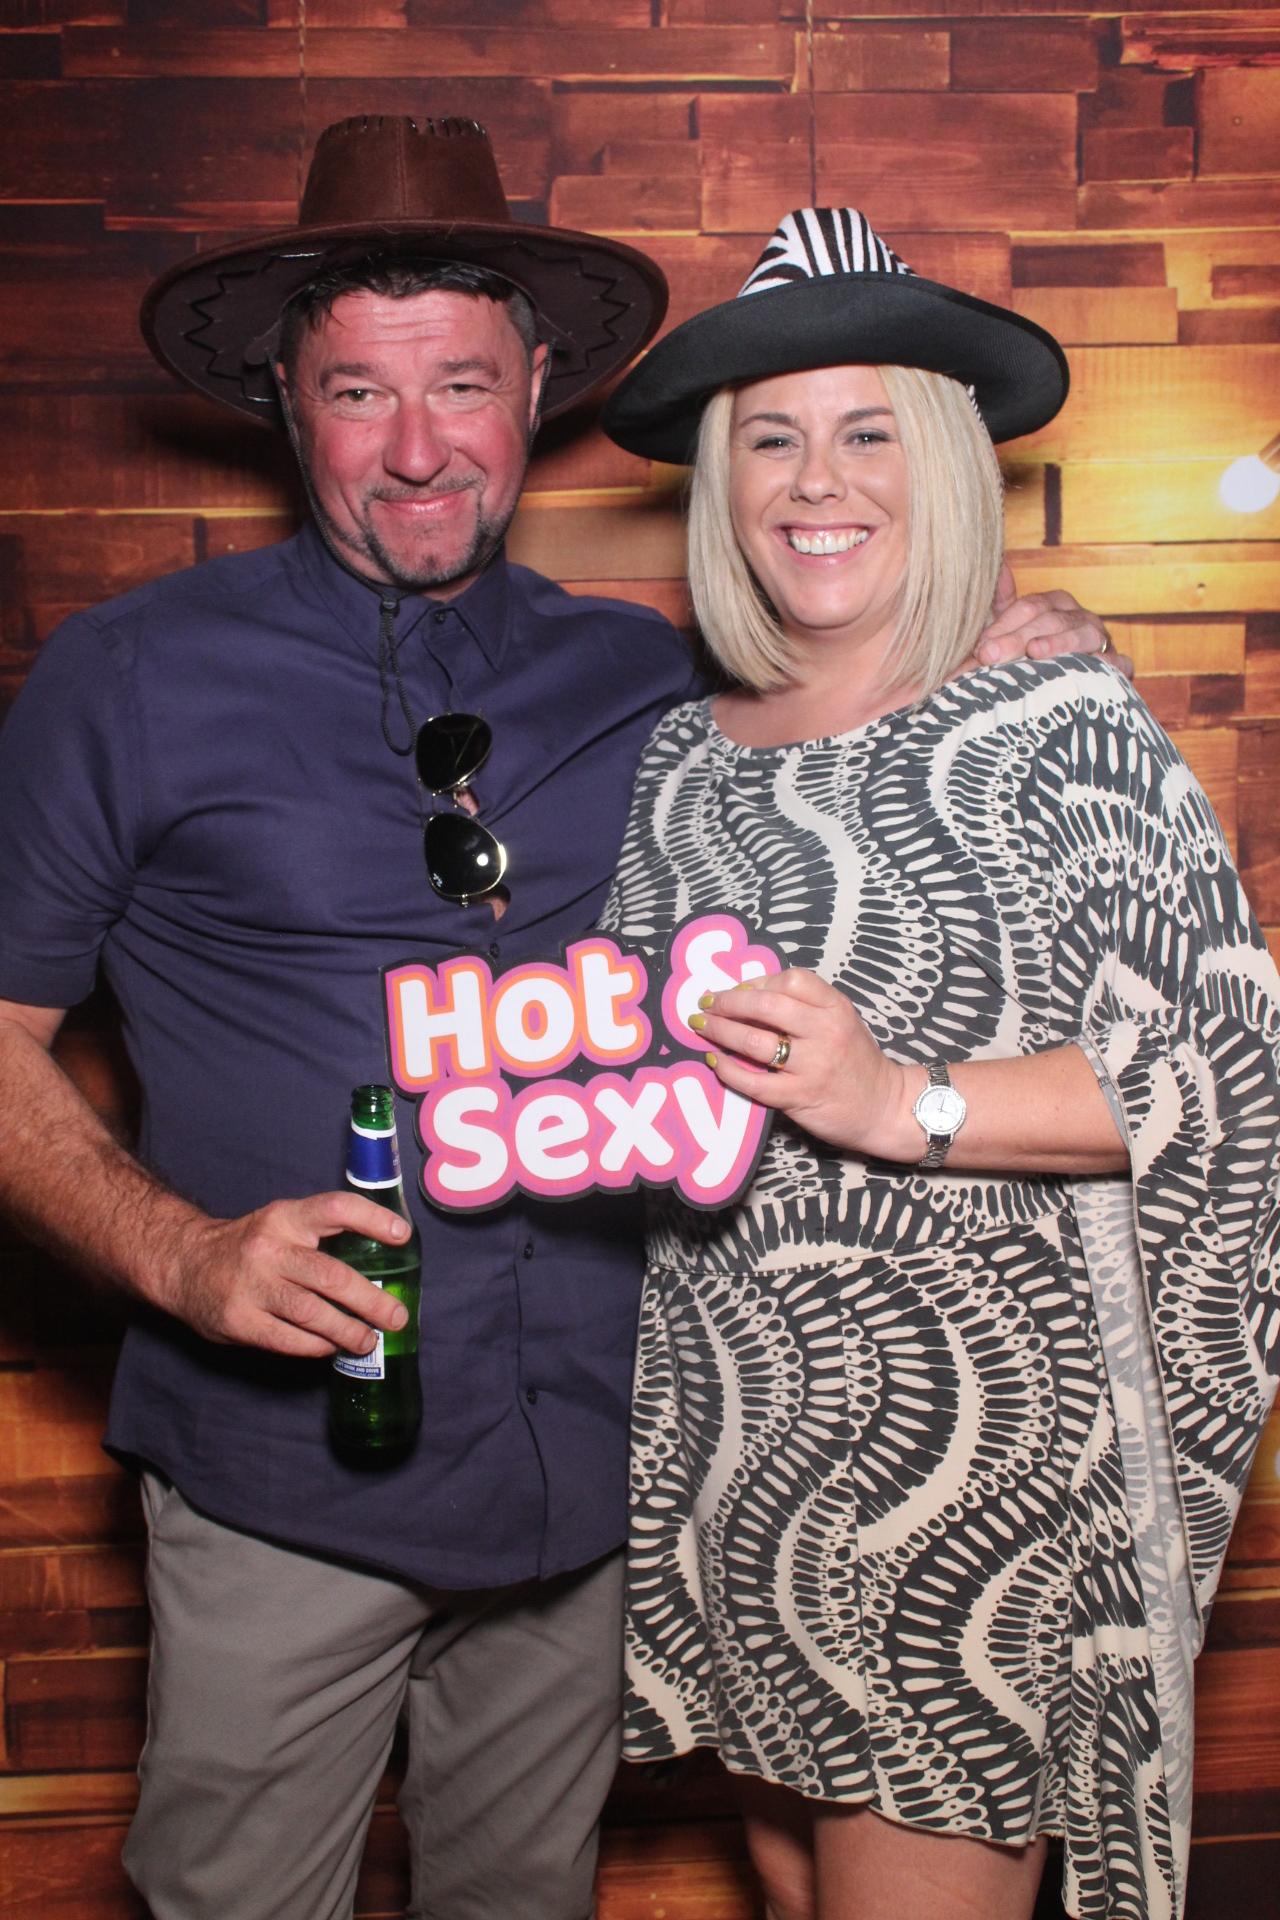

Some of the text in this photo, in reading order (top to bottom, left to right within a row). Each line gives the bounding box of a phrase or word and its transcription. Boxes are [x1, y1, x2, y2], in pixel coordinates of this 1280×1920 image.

[400, 930, 766, 1078] Hot &
[433, 1077, 752, 1191] Sexy
